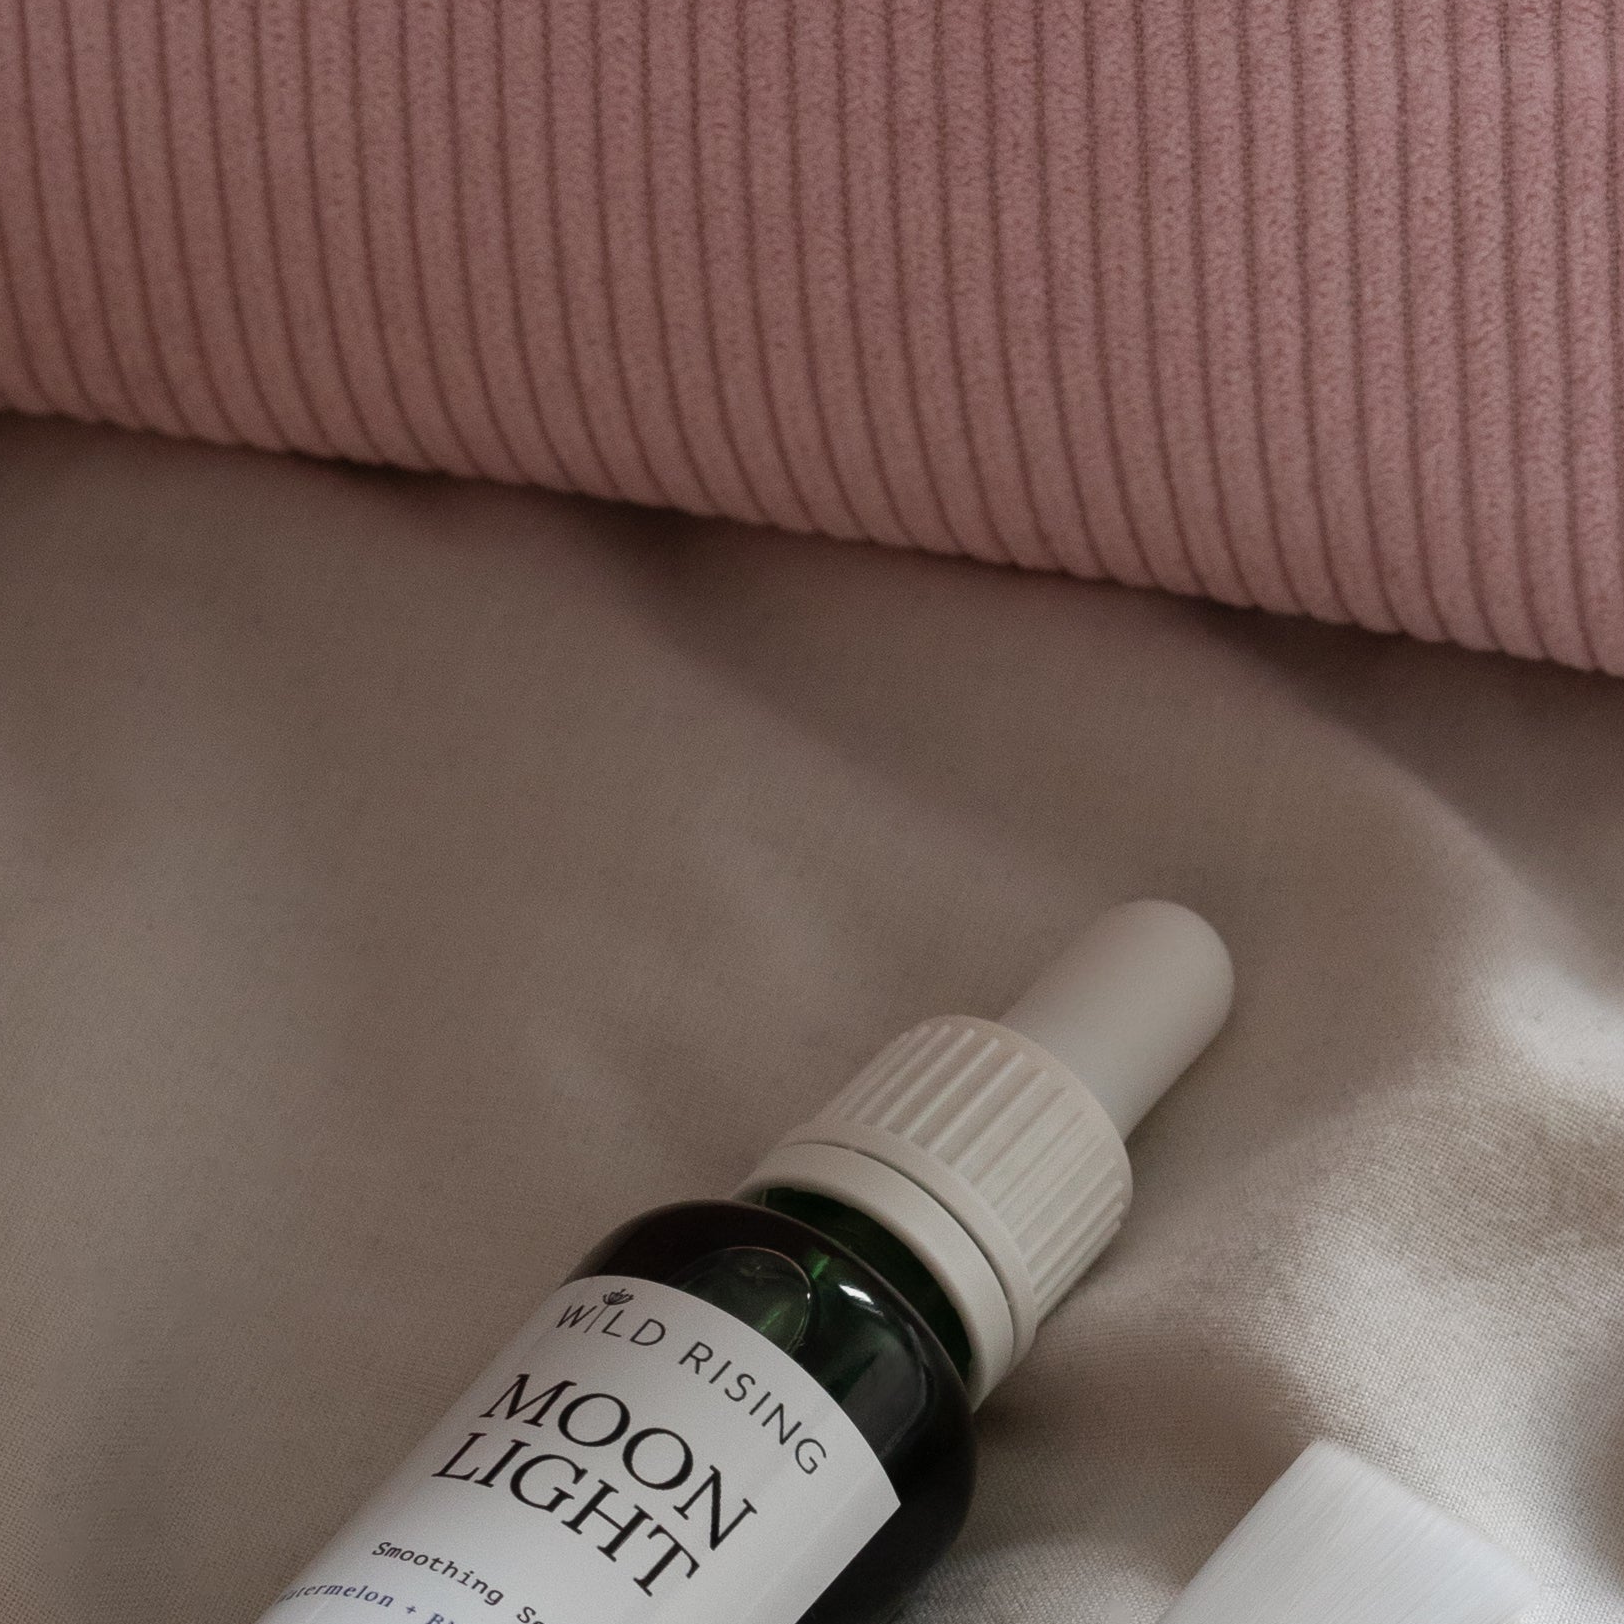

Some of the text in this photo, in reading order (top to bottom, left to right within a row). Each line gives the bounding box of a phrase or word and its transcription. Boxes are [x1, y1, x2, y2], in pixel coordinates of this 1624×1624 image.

[479, 1373, 757, 1551] MOON
[556, 1289, 828, 1475] WILD RISING
[372, 1541, 504, 1606] Smoothing
[432, 1432, 700, 1598] LIGHT
[406, 1605, 417, 1615] +
